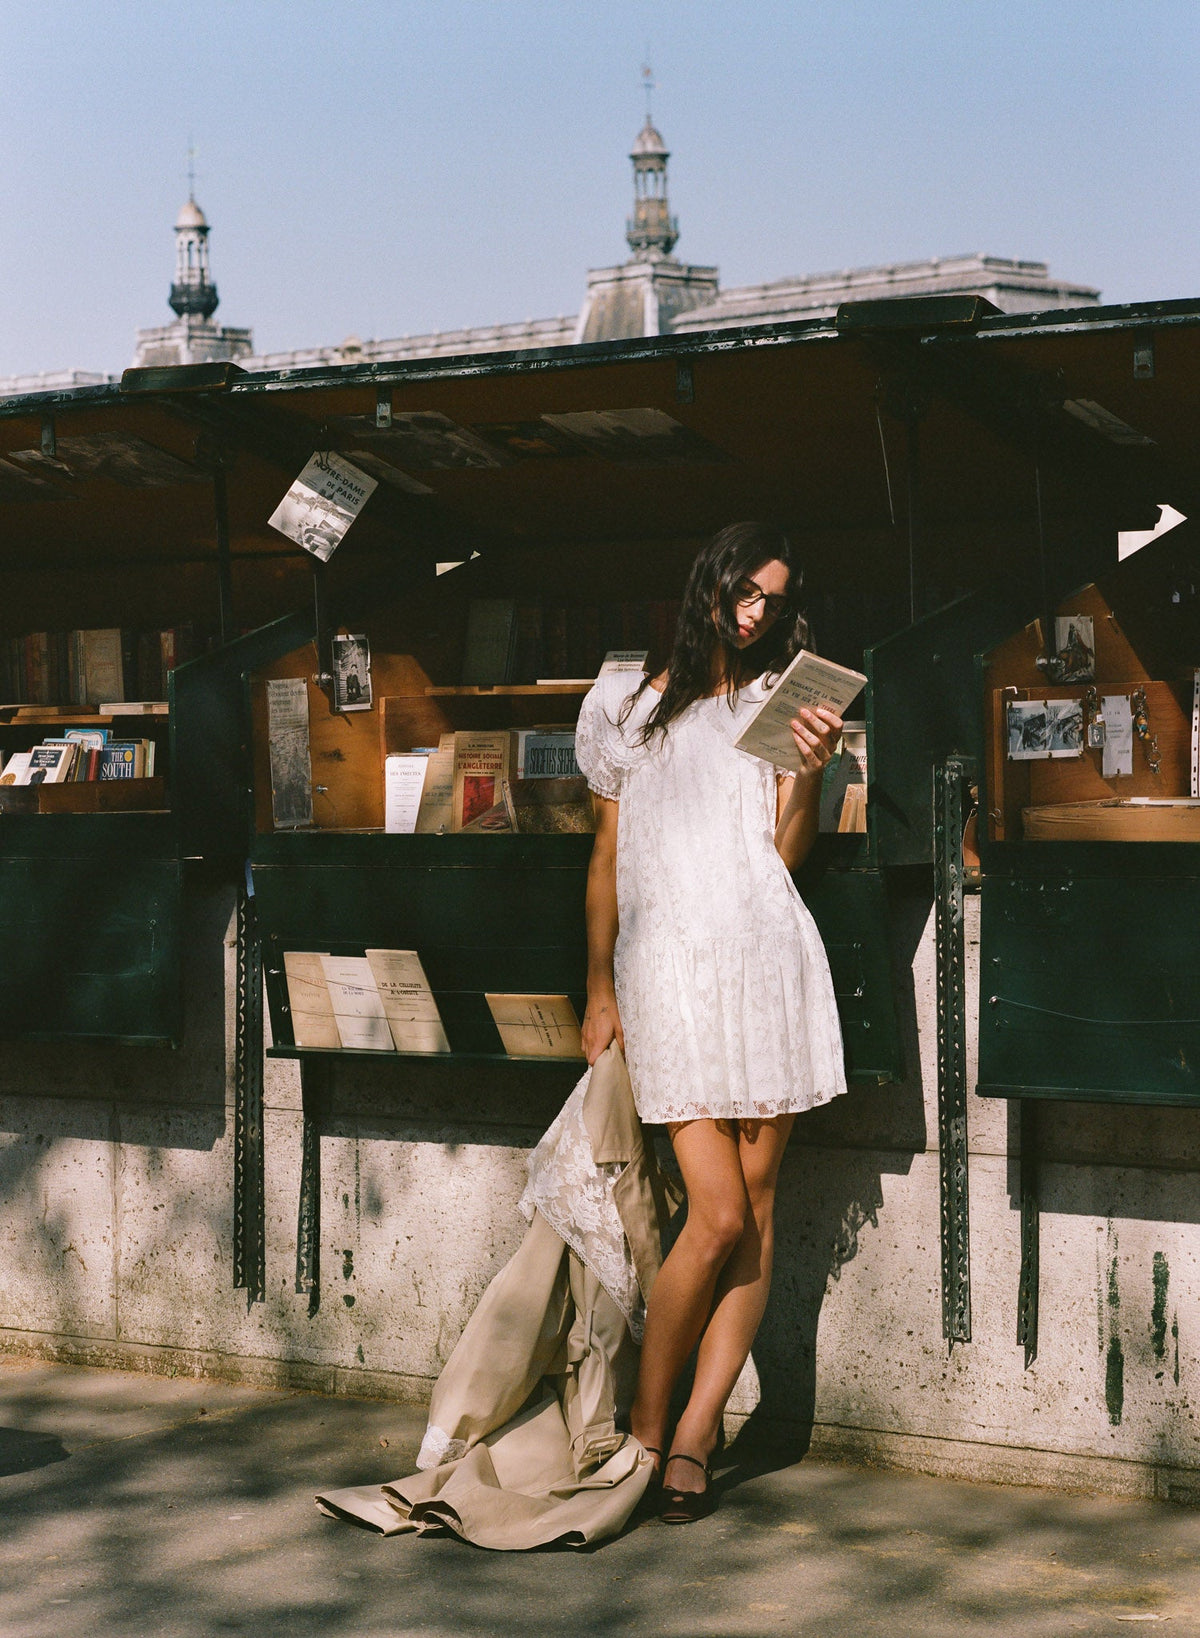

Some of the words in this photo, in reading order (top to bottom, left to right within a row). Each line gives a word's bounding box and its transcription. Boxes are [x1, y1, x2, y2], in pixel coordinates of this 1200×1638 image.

[313, 459, 366, 497] NOTRE-DAME
[326, 481, 336, 490] DE
[336, 486, 360, 505] PARIS
[111, 752, 124, 762] THE
[530, 744, 556, 775] SOCIÉTÉS
[102, 763, 132, 778] SOUTH
